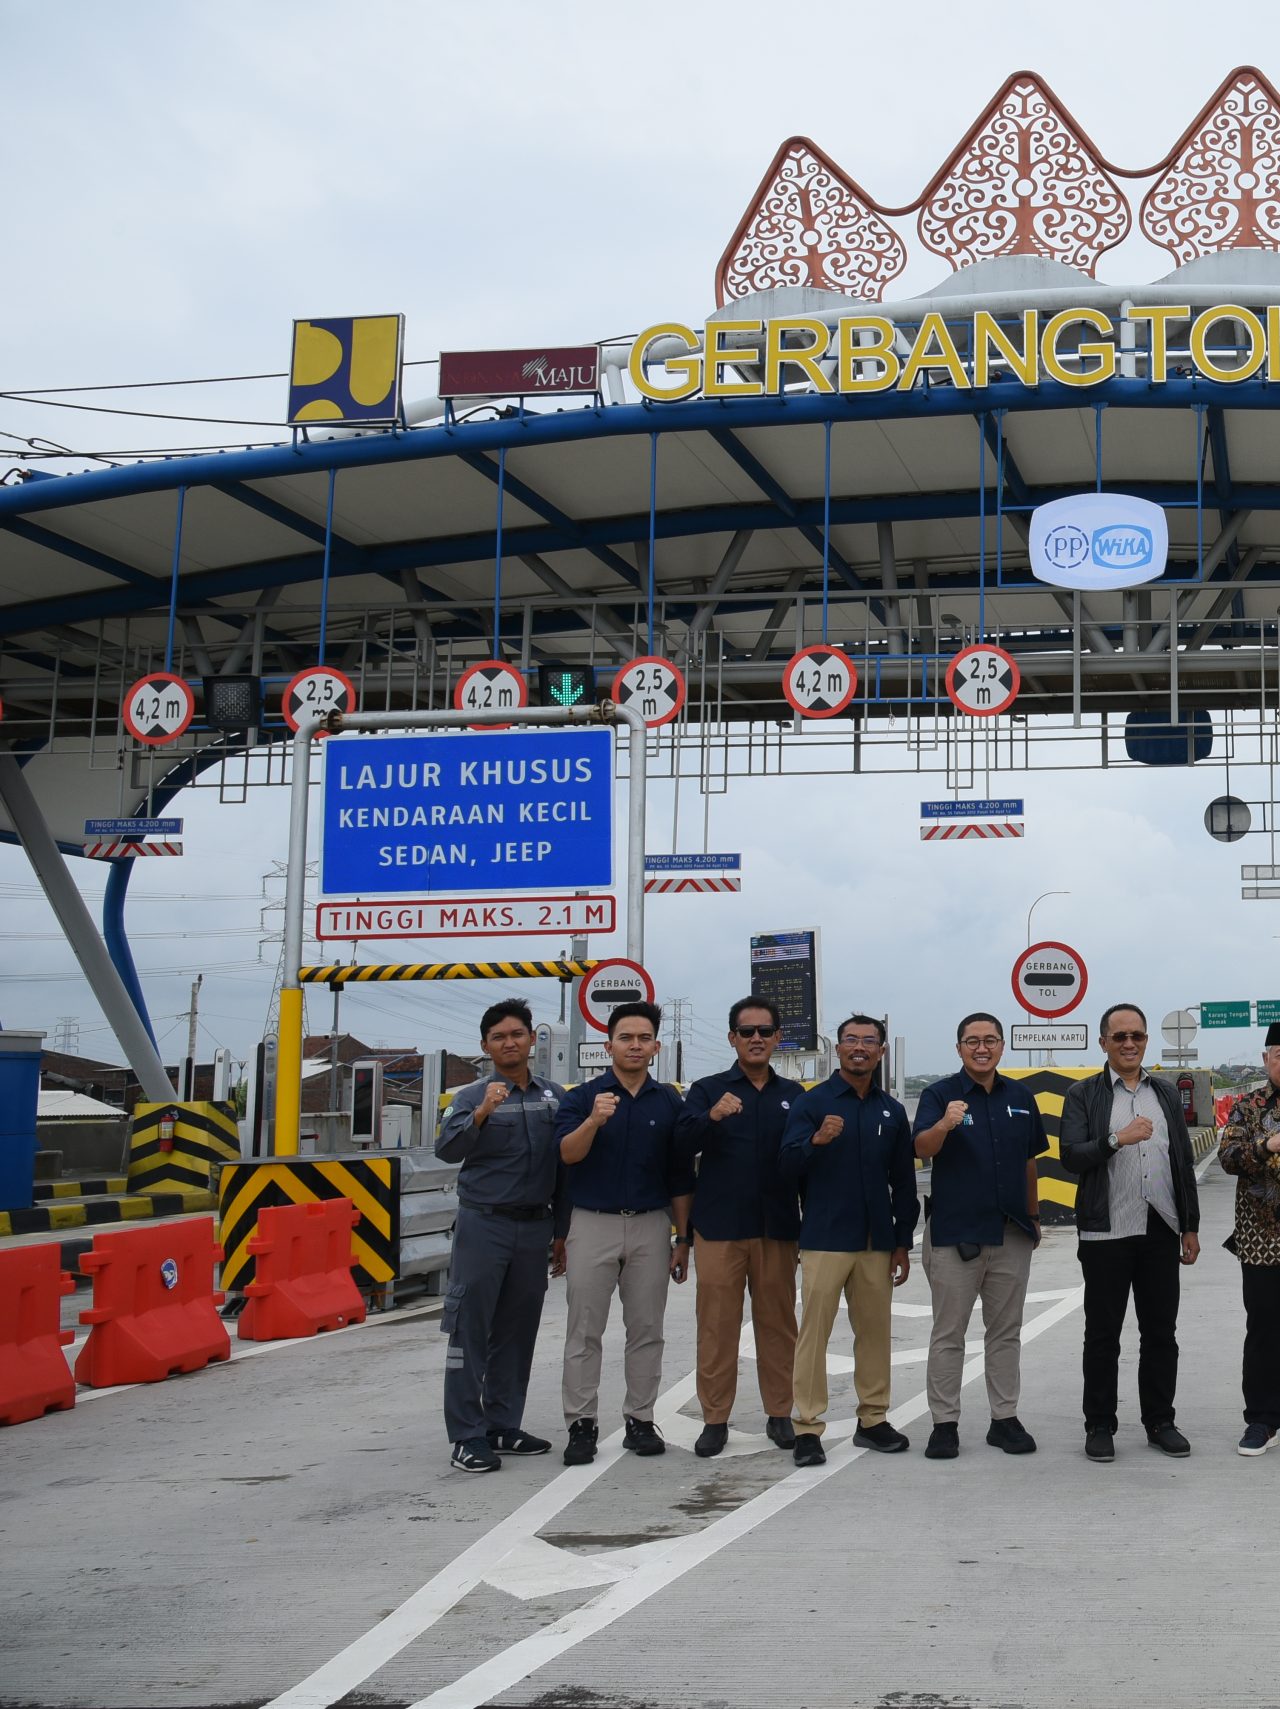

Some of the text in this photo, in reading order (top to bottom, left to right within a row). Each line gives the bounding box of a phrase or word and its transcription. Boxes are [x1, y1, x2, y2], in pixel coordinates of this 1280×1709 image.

[628, 308, 1116, 401] GERBANG
[534, 365, 597, 391] MAJU
[1054, 537, 1083, 558] PP
[635, 669, 663, 694] 2,5
[969, 657, 998, 683] 2,5
[305, 679, 334, 704] 2,5
[795, 670, 843, 697] 4,2 m
[976, 687, 991, 705] m
[467, 686, 513, 709] 4,2 m
[642, 698, 657, 716] m
[135, 697, 180, 724] 4,2 m
[339, 757, 593, 790] LAJUR KHUSUS
[339, 800, 592, 828] KENDARAAN KECIL
[927, 803, 953, 811] TINGGI
[955, 802, 976, 810] MAKS
[978, 801, 1000, 810] 4.200
[378, 841, 552, 867] SEDAN, JEEP
[329, 904, 604, 931] TINGGI MAKS. 2.1 M
[1026, 962, 1074, 970] GERBANG
[593, 979, 641, 987] GERBANG
[1039, 989, 1057, 997] TOL
[1014, 1033, 1085, 1042] TEMPELKAN KARTU
